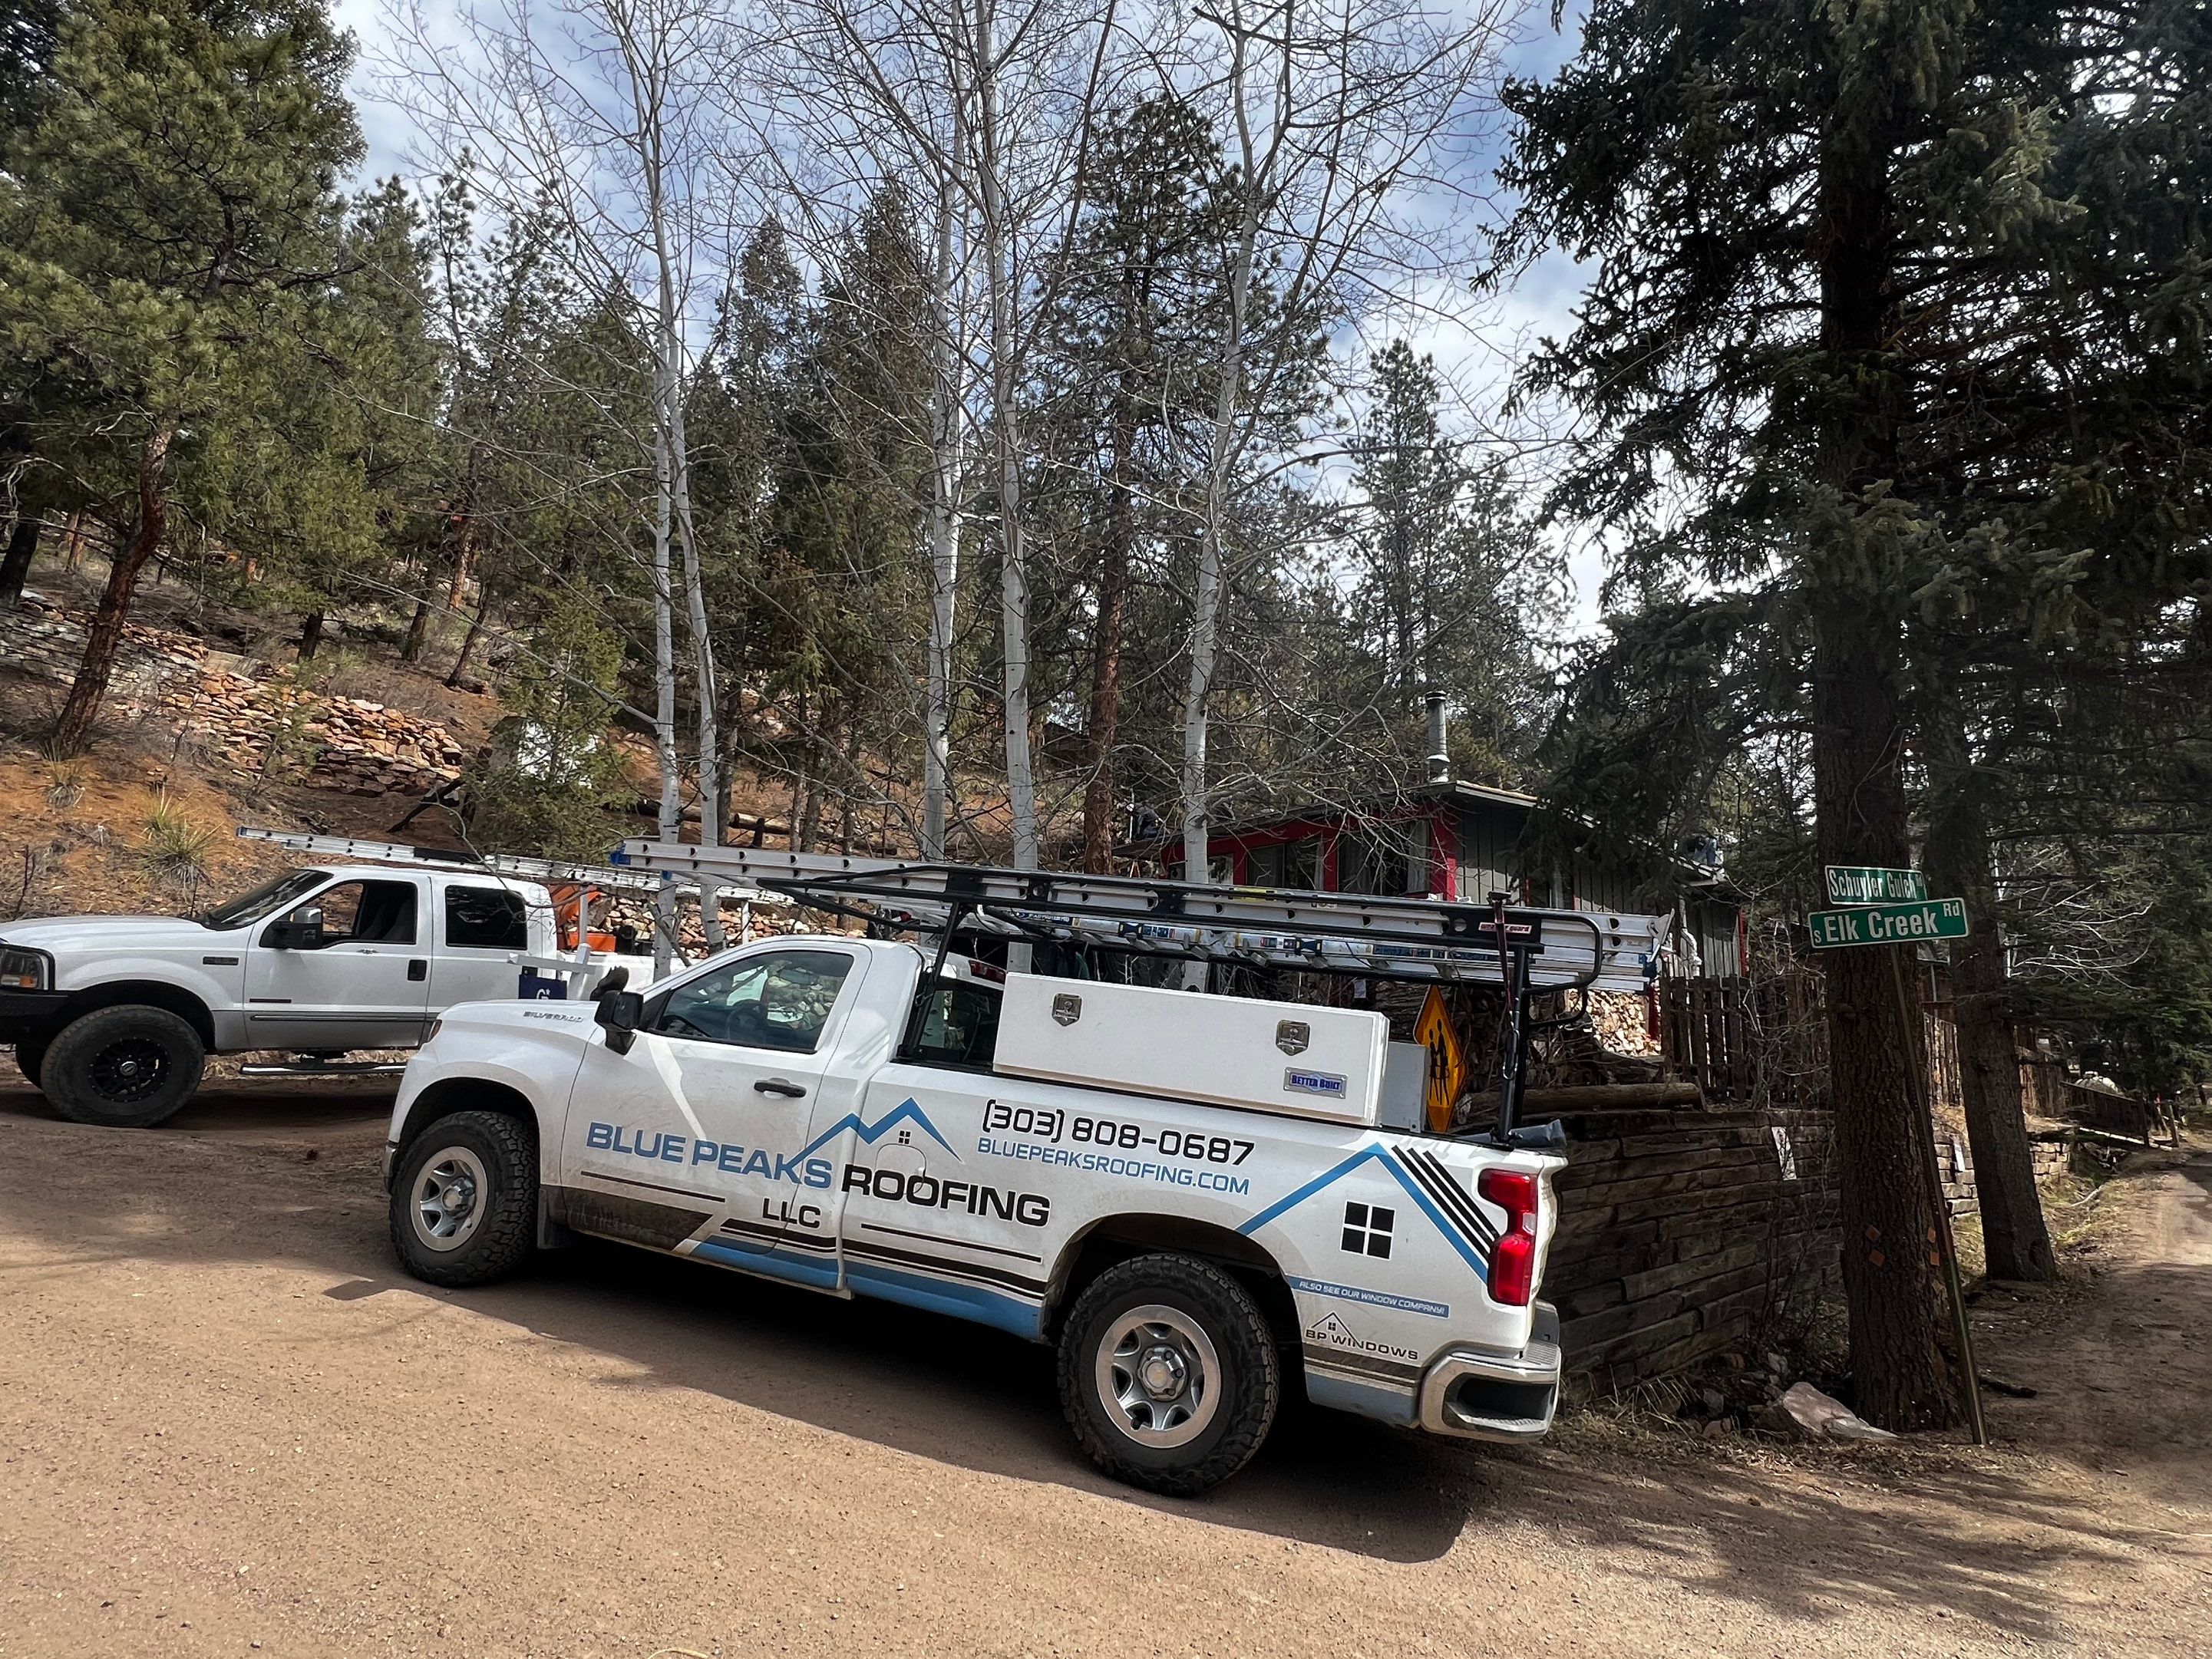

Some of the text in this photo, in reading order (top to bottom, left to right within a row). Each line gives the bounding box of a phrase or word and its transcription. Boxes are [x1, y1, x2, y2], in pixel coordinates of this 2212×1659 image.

[1828, 869, 1883, 901] Schuyler
[1887, 872, 1917, 899] Gulch
[1824, 915, 1860, 942] Elk
[1867, 907, 1940, 938] Creek
[1943, 902, 1960, 917] Rd
[1291, 1074, 1341, 1090] BETTER BUILT
[982, 1099, 1255, 1166] (303) 808-0687
[586, 1121, 1052, 1226] BLUE PEAKS ROOFING
[977, 1136, 1251, 1196] BLUEPEAKSROOFING.COM
[761, 1197, 822, 1229] LLC
[1299, 1281, 1322, 1291] ALSO
[1323, 1286, 1340, 1295] SEE
[1341, 1289, 1360, 1299] OUR
[1361, 1292, 1398, 1306] WINDOW
[1305, 1328, 1419, 1361] BP WINDOWS
